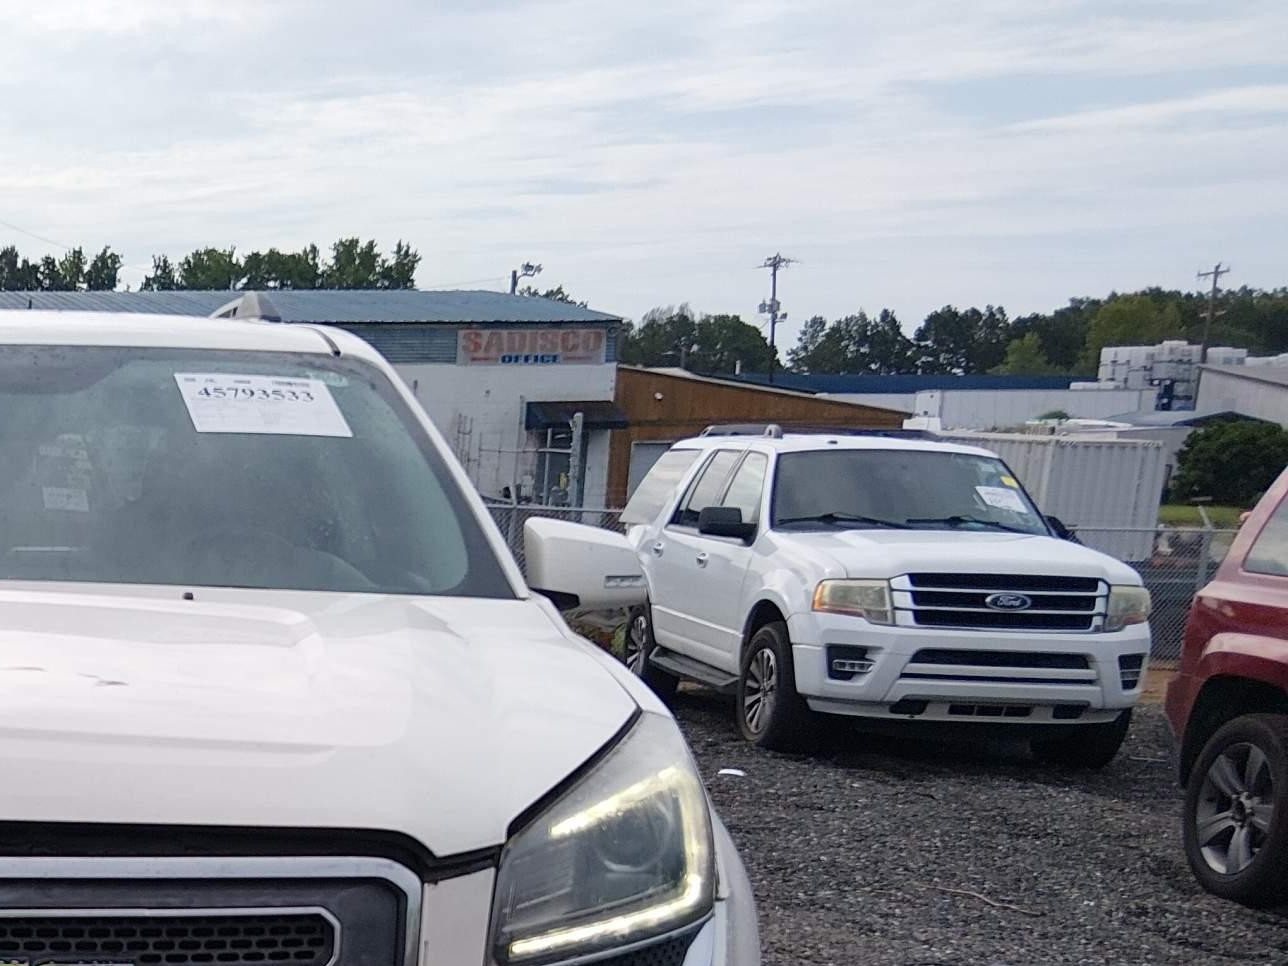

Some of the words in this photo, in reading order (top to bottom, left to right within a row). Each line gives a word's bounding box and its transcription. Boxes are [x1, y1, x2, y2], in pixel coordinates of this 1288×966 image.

[461, 331, 603, 353] SADISCO
[500, 354, 560, 364] OFFICE
[197, 387, 314, 402] 45793533
